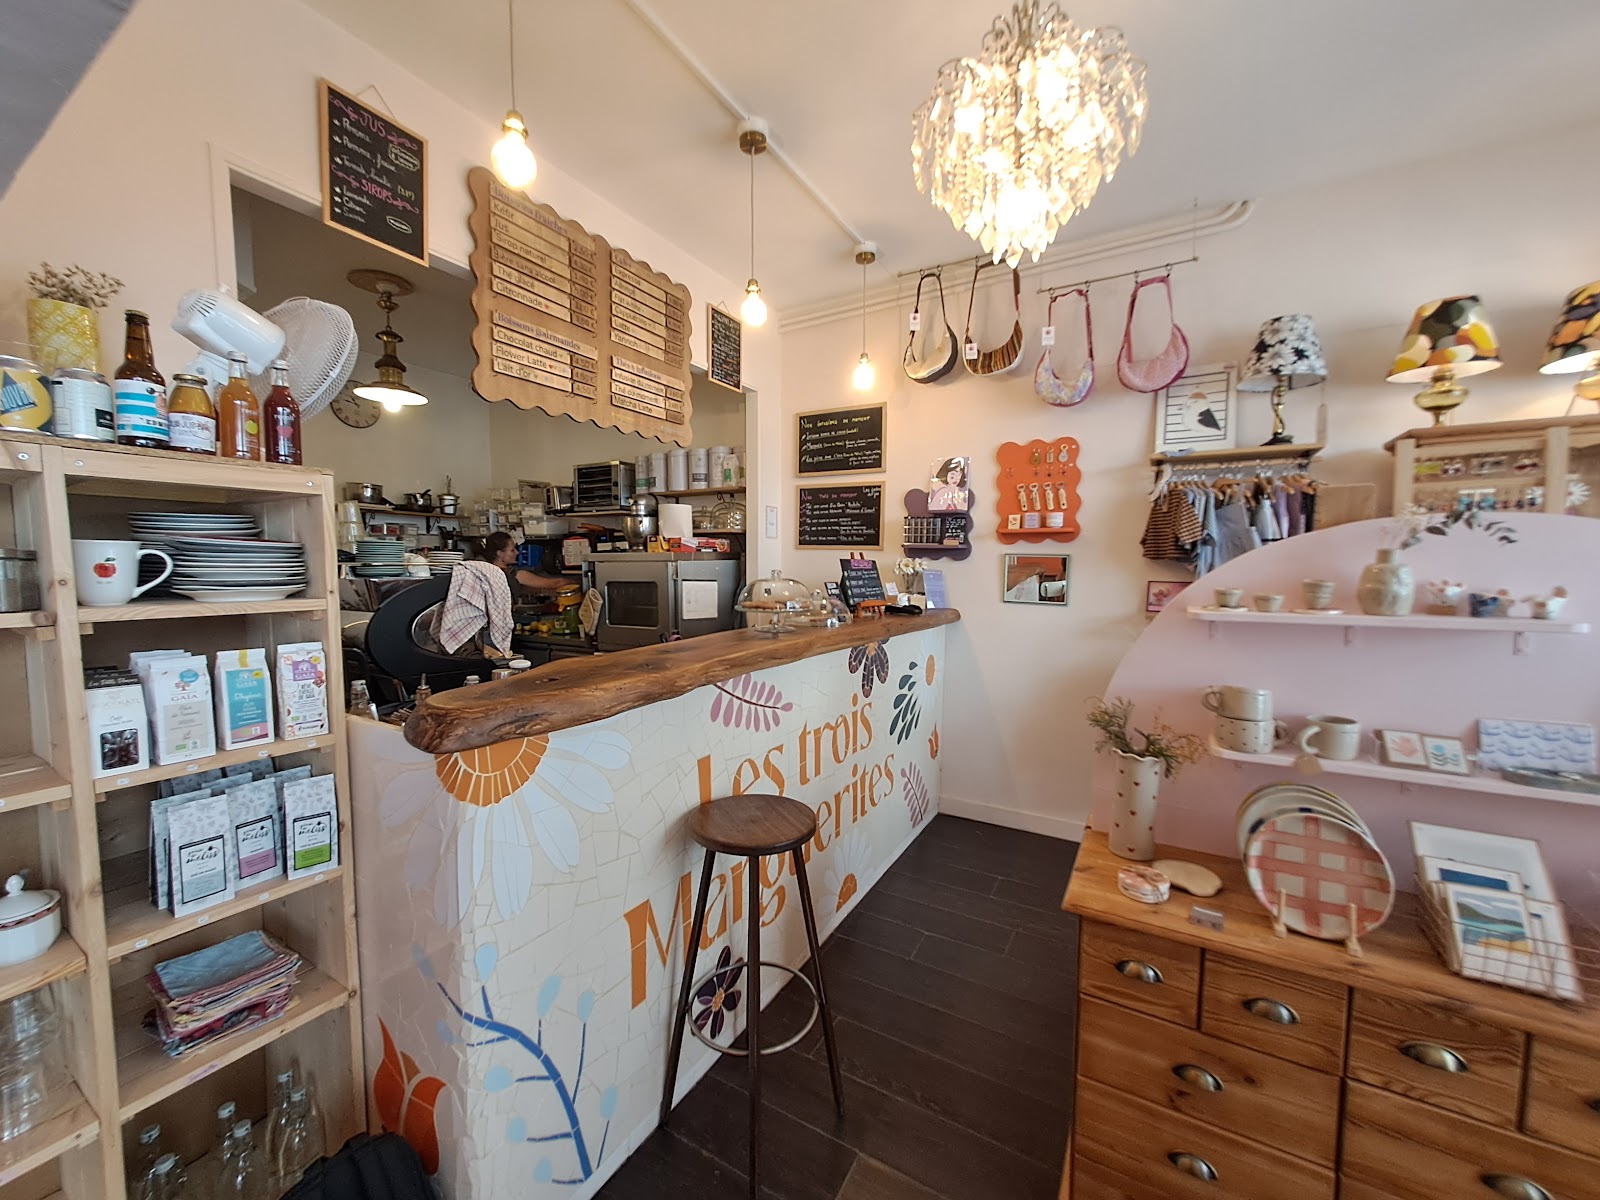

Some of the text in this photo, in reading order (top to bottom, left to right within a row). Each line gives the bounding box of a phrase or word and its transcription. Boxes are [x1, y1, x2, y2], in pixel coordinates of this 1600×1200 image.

[359, 110, 385, 137] JUS
[361, 179, 393, 203] SIROPS
[493, 201, 514, 219] Kéfir
[494, 219, 509, 233] Jus
[496, 232, 518, 250] Sirop
[520, 245, 547, 264] naturel
[497, 265, 513, 279] Thé
[514, 274, 535, 290] glacé
[515, 259, 533, 274] sans
[534, 268, 556, 285] alcool
[496, 281, 543, 306] Citronnade
[498, 312, 535, 333] Boissons
[614, 318, 631, 332] Latte
[497, 329, 534, 350] Chocolat
[534, 344, 558, 358] chaud
[496, 345, 525, 361] Flower
[526, 355, 547, 369] Latte
[497, 362, 514, 375] Lait
[515, 367, 532, 379] d'or
[614, 384, 626, 395] Thé
[614, 395, 653, 414] Matcha Latte
[798, 692, 874, 787] trois
